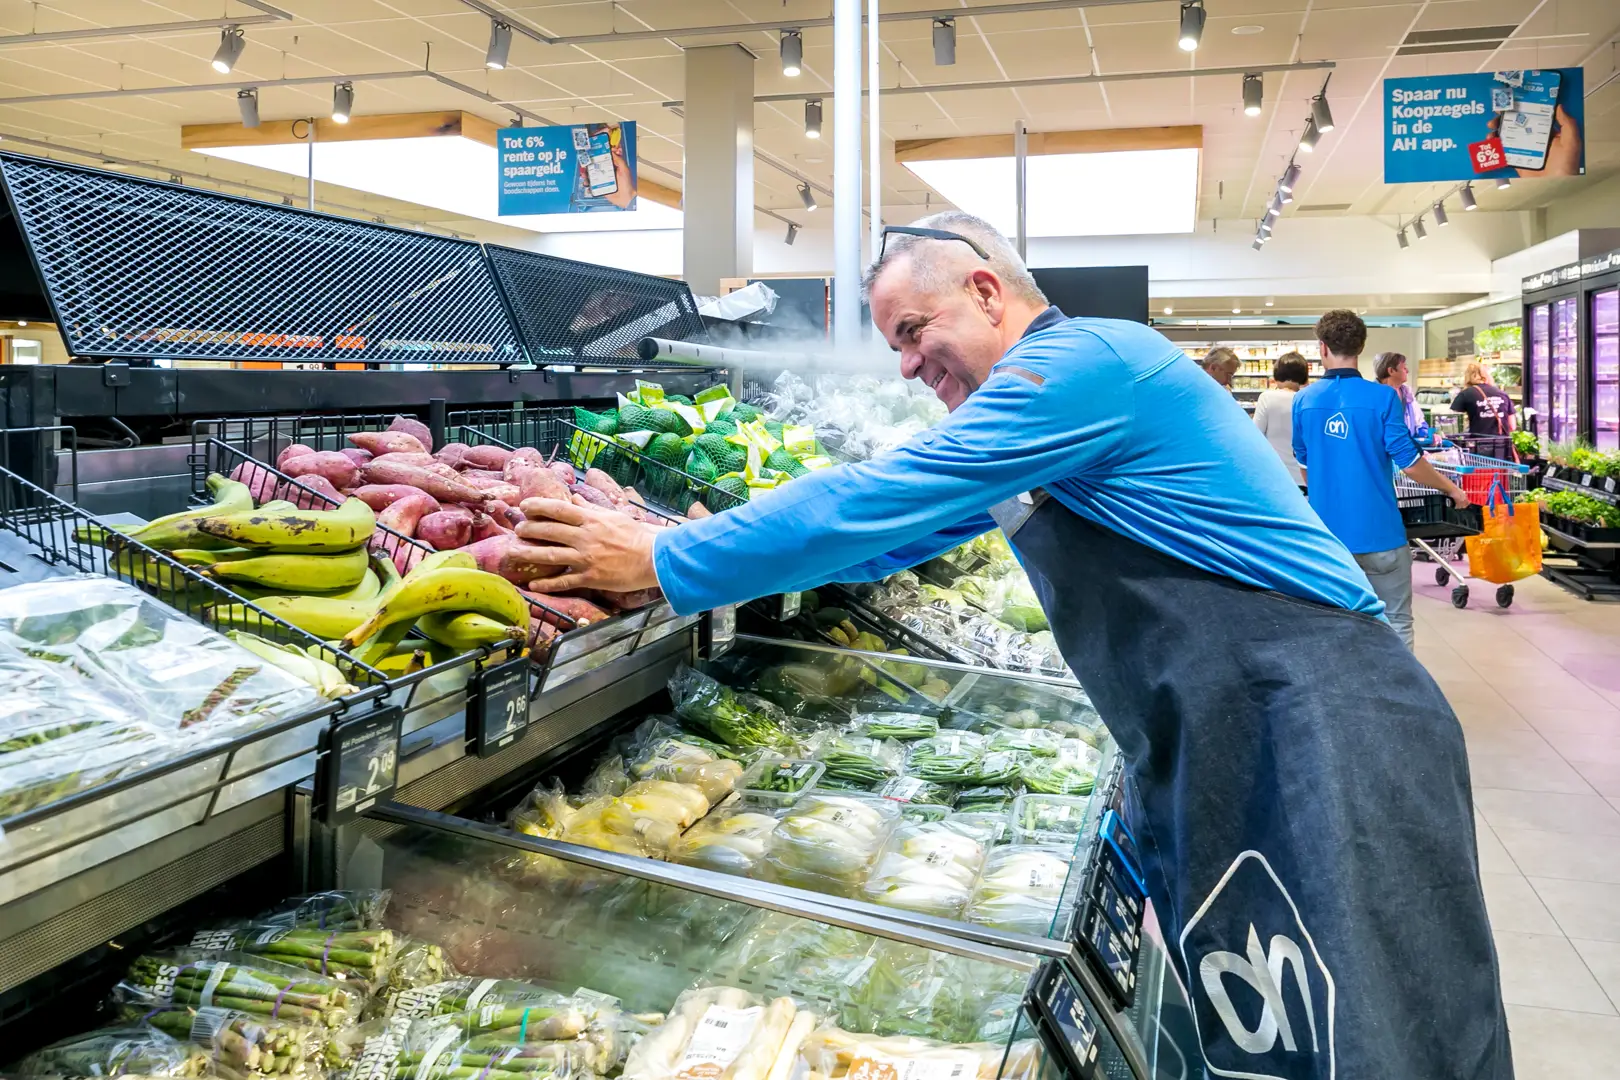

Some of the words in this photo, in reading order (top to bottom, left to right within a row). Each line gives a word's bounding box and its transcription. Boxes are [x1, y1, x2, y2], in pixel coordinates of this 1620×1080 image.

[1392, 88, 1441, 105] Spaar
[1445, 87, 1467, 100] nu
[1392, 101, 1485, 119] Koopzegels
[1392, 121, 1407, 135] in
[1412, 119, 1433, 134] de
[503, 137, 523, 149] Tot
[525, 136, 544, 148] 6%
[1392, 137, 1417, 151] AH
[1421, 138, 1457, 152] app.
[1478, 143, 1492, 151] Tot
[503, 150, 534, 162] rente
[537, 150, 553, 163] op
[555, 148, 567, 162] je
[1476, 148, 1500, 163] 6%
[503, 163, 564, 178] spaargeld.
[1479, 159, 1500, 169] rente
[503, 187, 544, 195] boodschappen
[527, 180, 545, 188] tijdens
